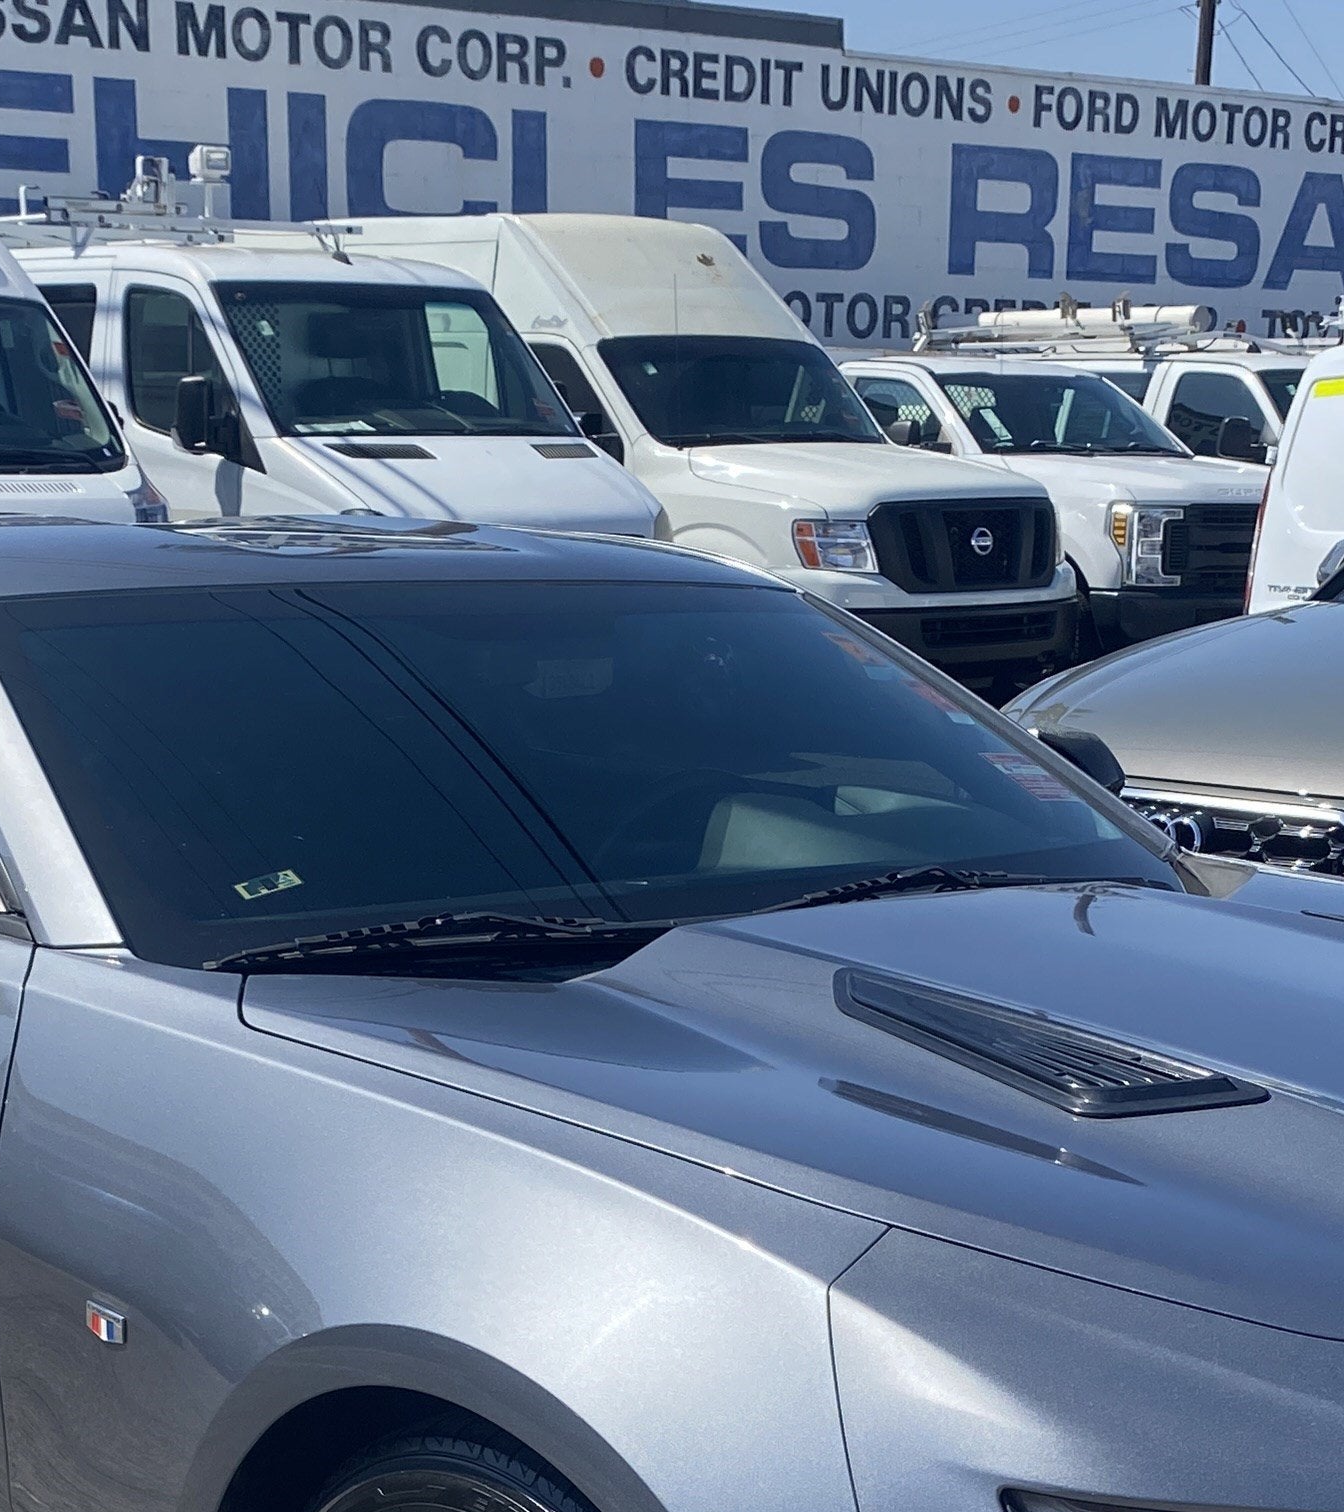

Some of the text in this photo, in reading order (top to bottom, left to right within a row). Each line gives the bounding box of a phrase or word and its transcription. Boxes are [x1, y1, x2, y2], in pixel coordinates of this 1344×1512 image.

[177, 1, 392, 73] MOTOR
[416, 23, 571, 88] CORP.
[625, 46, 803, 106] CREDIT
[821, 65, 992, 124] UNIONS
[1033, 84, 1139, 135] FORD
[1154, 98, 1290, 151] MOTOR
